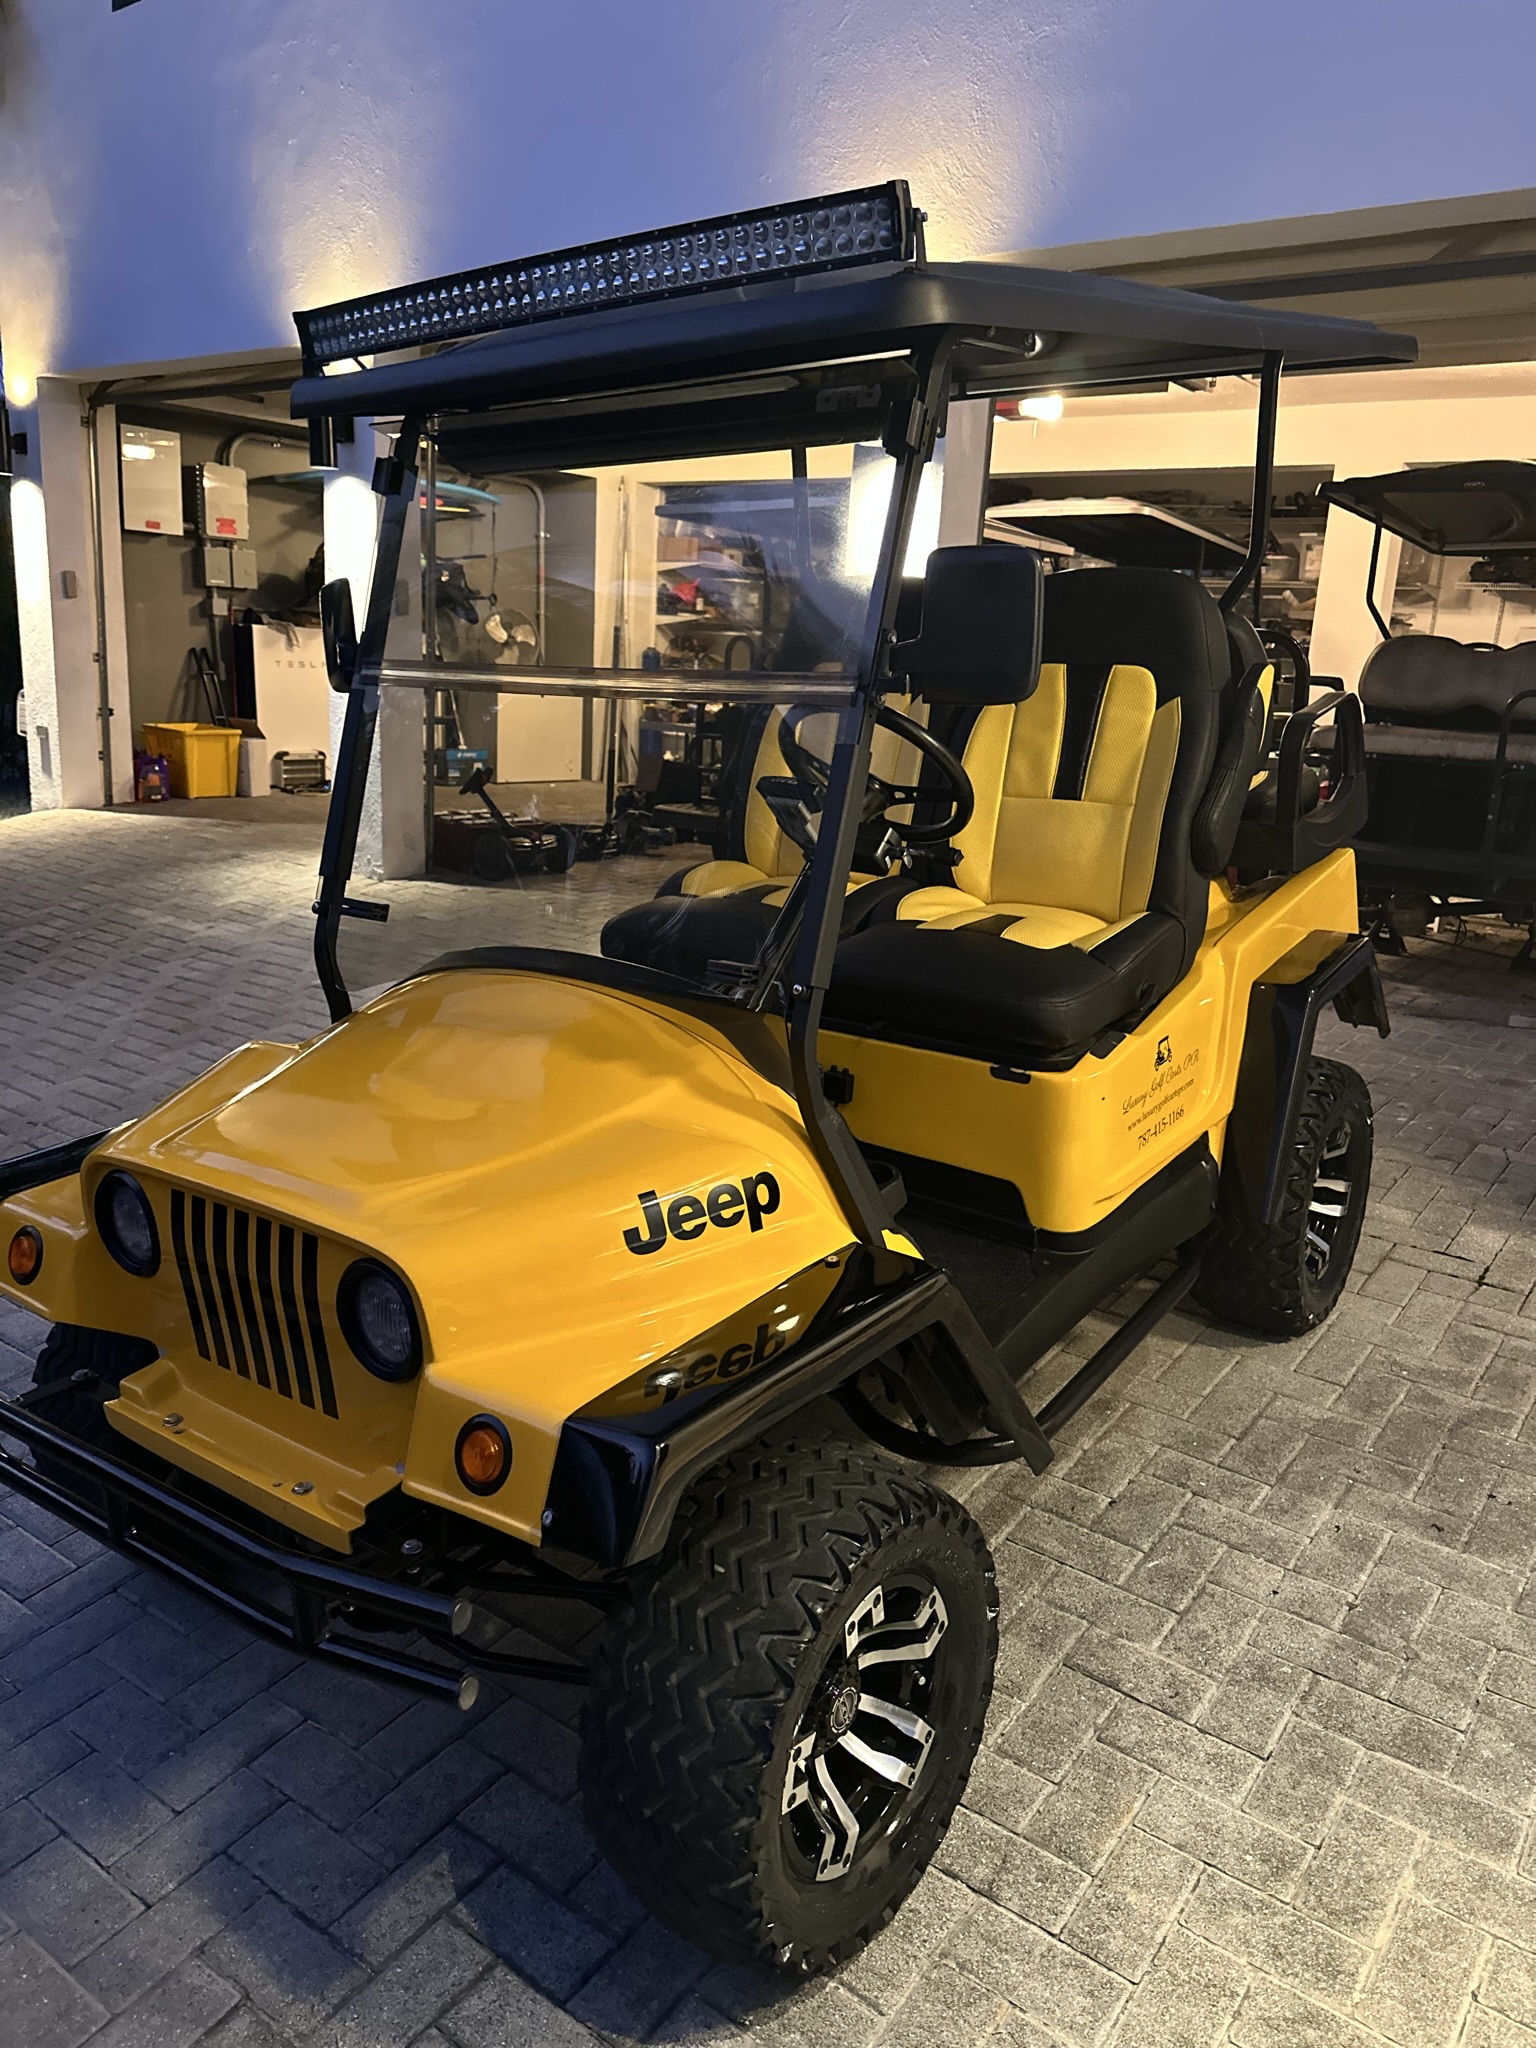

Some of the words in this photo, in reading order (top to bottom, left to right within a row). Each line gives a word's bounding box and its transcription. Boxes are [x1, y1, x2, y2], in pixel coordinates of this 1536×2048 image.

[1122, 1091, 1148, 1115] Luxury
[1149, 1071, 1166, 1098] Golf
[1166, 1065, 1182, 1084] Carts
[1137, 1104, 1185, 1151] 787-415-1166
[623, 1171, 781, 1255] Jeep
